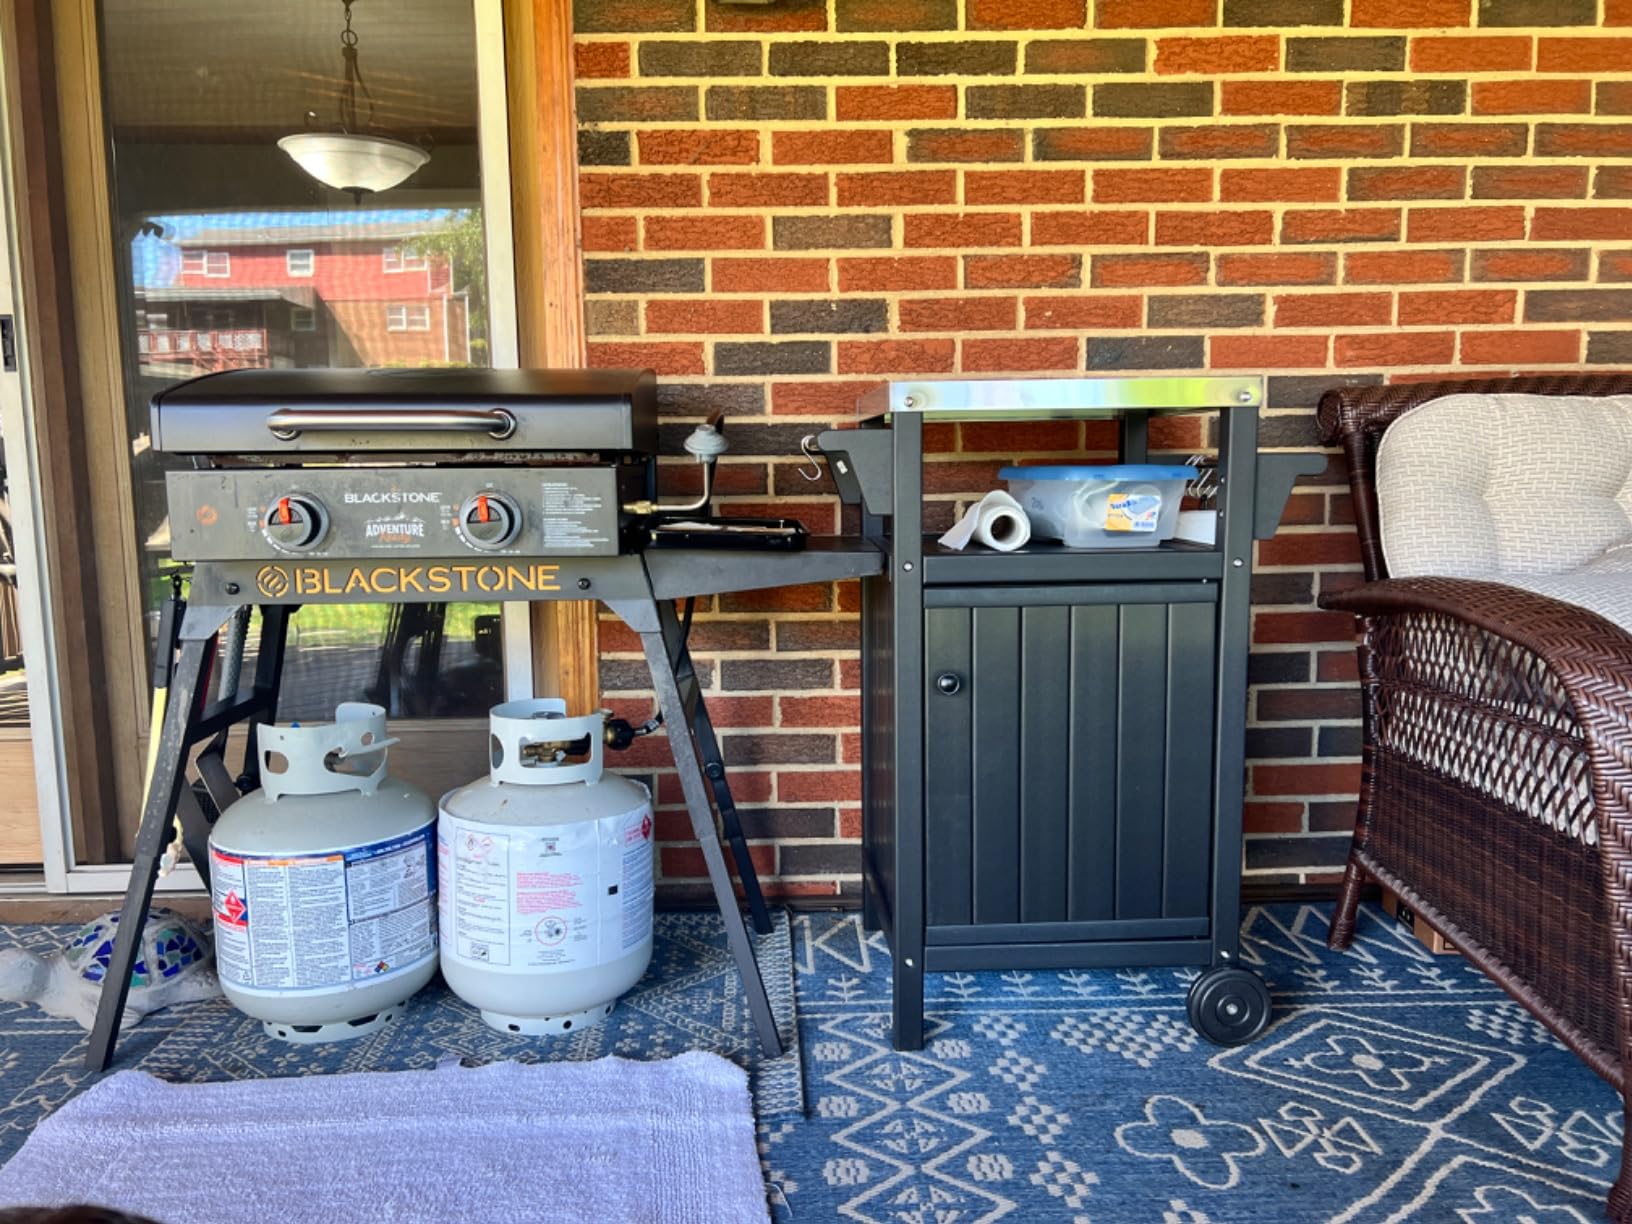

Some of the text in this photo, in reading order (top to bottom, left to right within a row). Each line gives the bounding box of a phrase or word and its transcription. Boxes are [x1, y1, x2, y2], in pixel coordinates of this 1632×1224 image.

[344, 492, 441, 504] BLACKSTONE
[365, 523, 424, 538] ADVENTURE
[294, 565, 561, 594] BLACKSTONE
